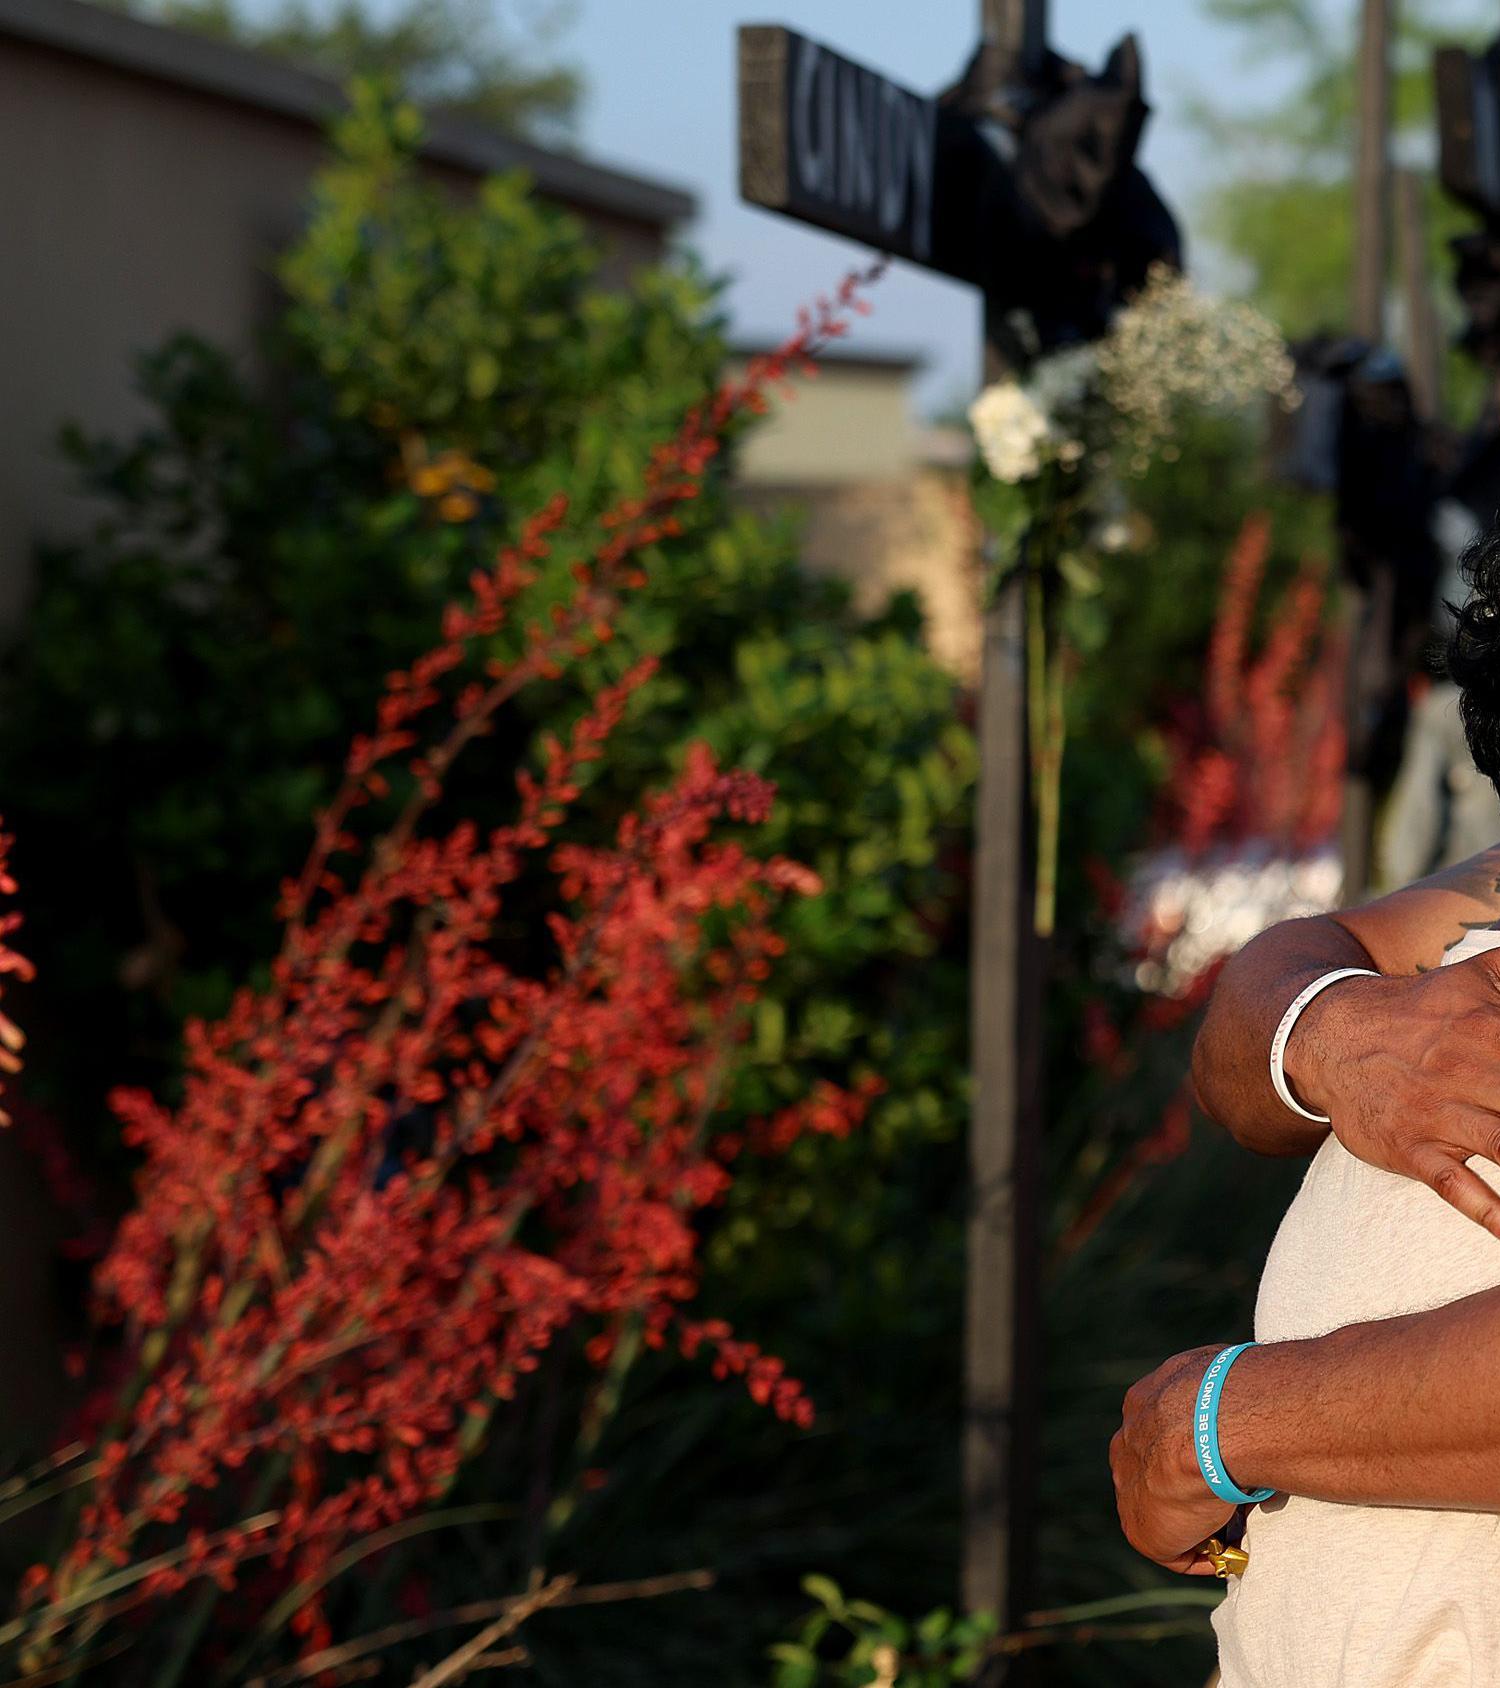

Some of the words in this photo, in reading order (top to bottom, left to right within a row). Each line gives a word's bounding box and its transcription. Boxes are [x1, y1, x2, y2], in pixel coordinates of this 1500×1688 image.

[1208, 1365, 1221, 1380] TO
[1200, 1381, 1215, 1410] KIND
[1199, 1413, 1209, 1431] BE
[1199, 1433, 1222, 1484] ALWAYS
